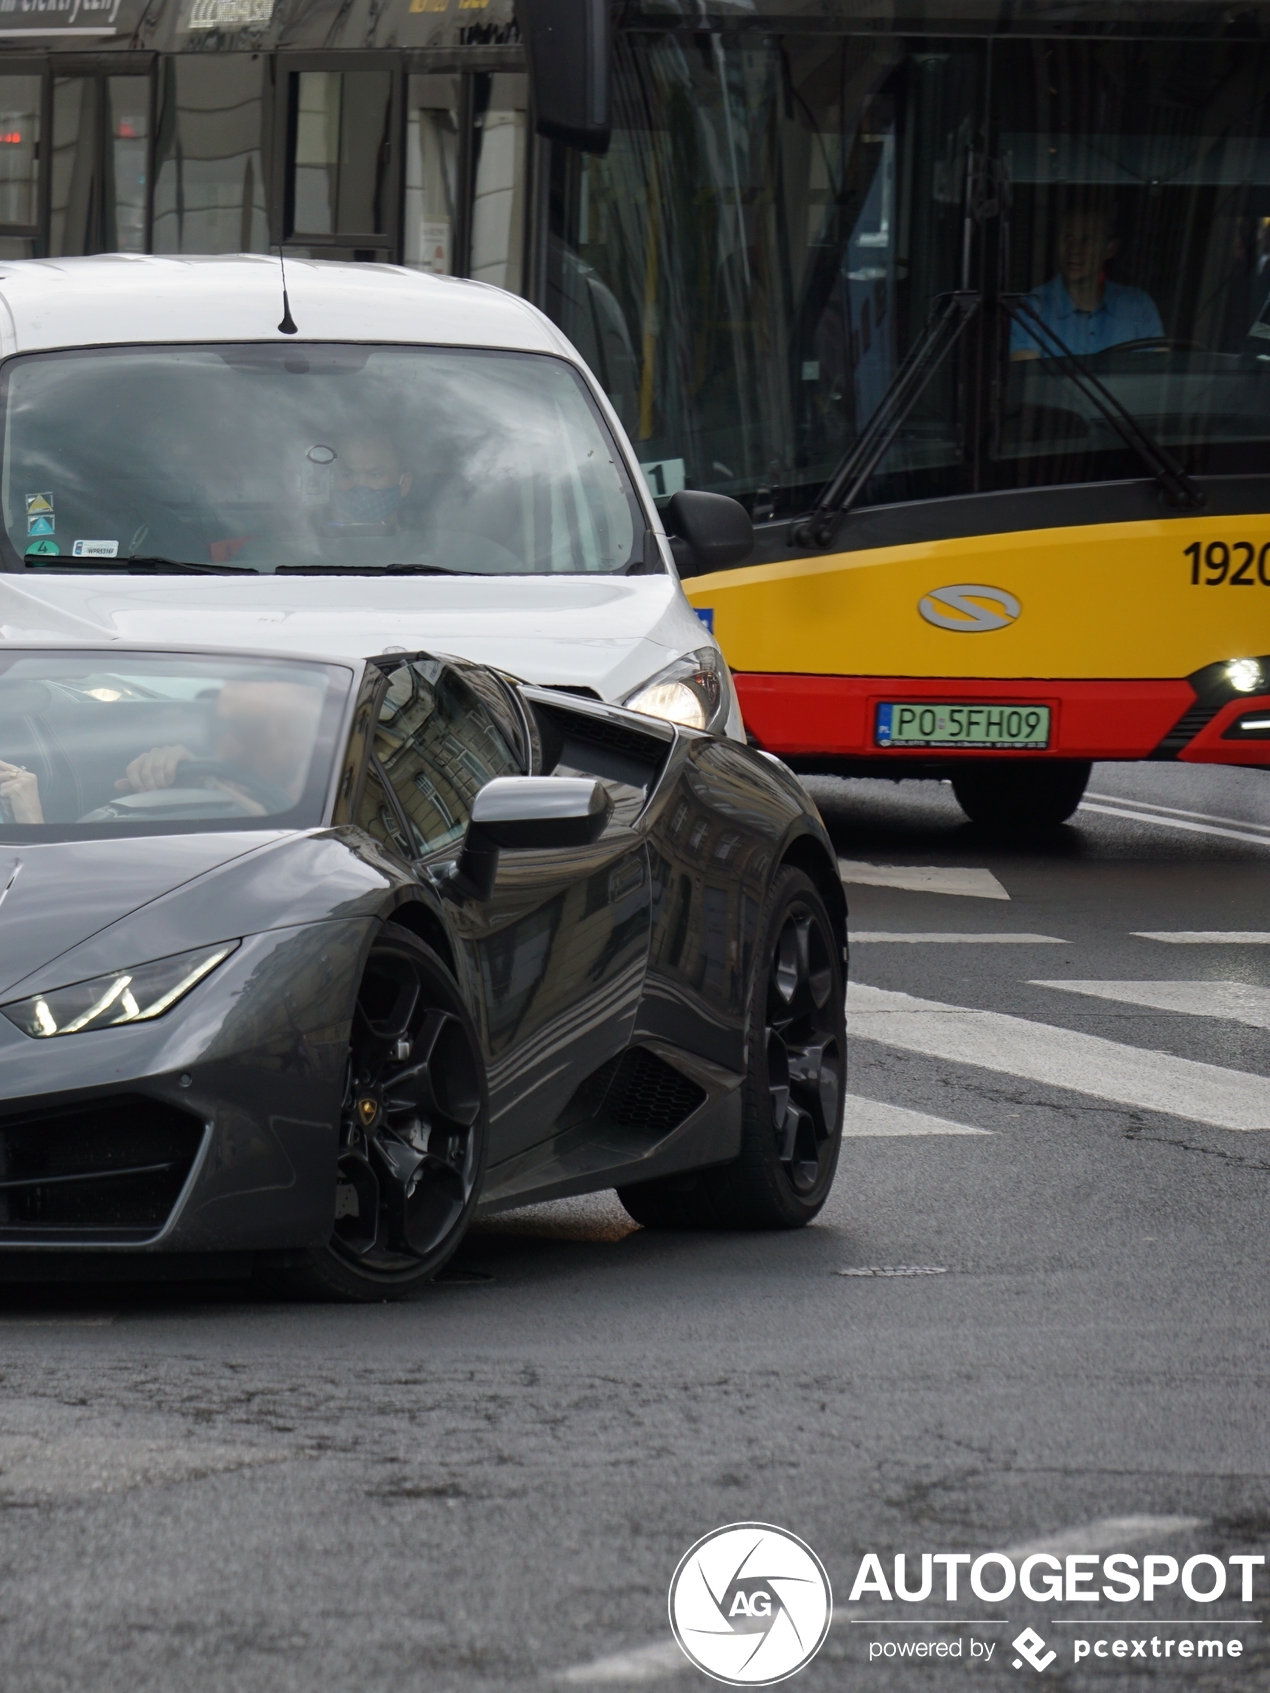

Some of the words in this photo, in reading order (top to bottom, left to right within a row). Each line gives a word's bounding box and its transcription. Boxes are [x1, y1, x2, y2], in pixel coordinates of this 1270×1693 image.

[648, 464, 667, 495] 1
[38, 541, 48, 554] 4
[898, 708, 936, 736] PO
[948, 709, 1041, 739] 5FH09
